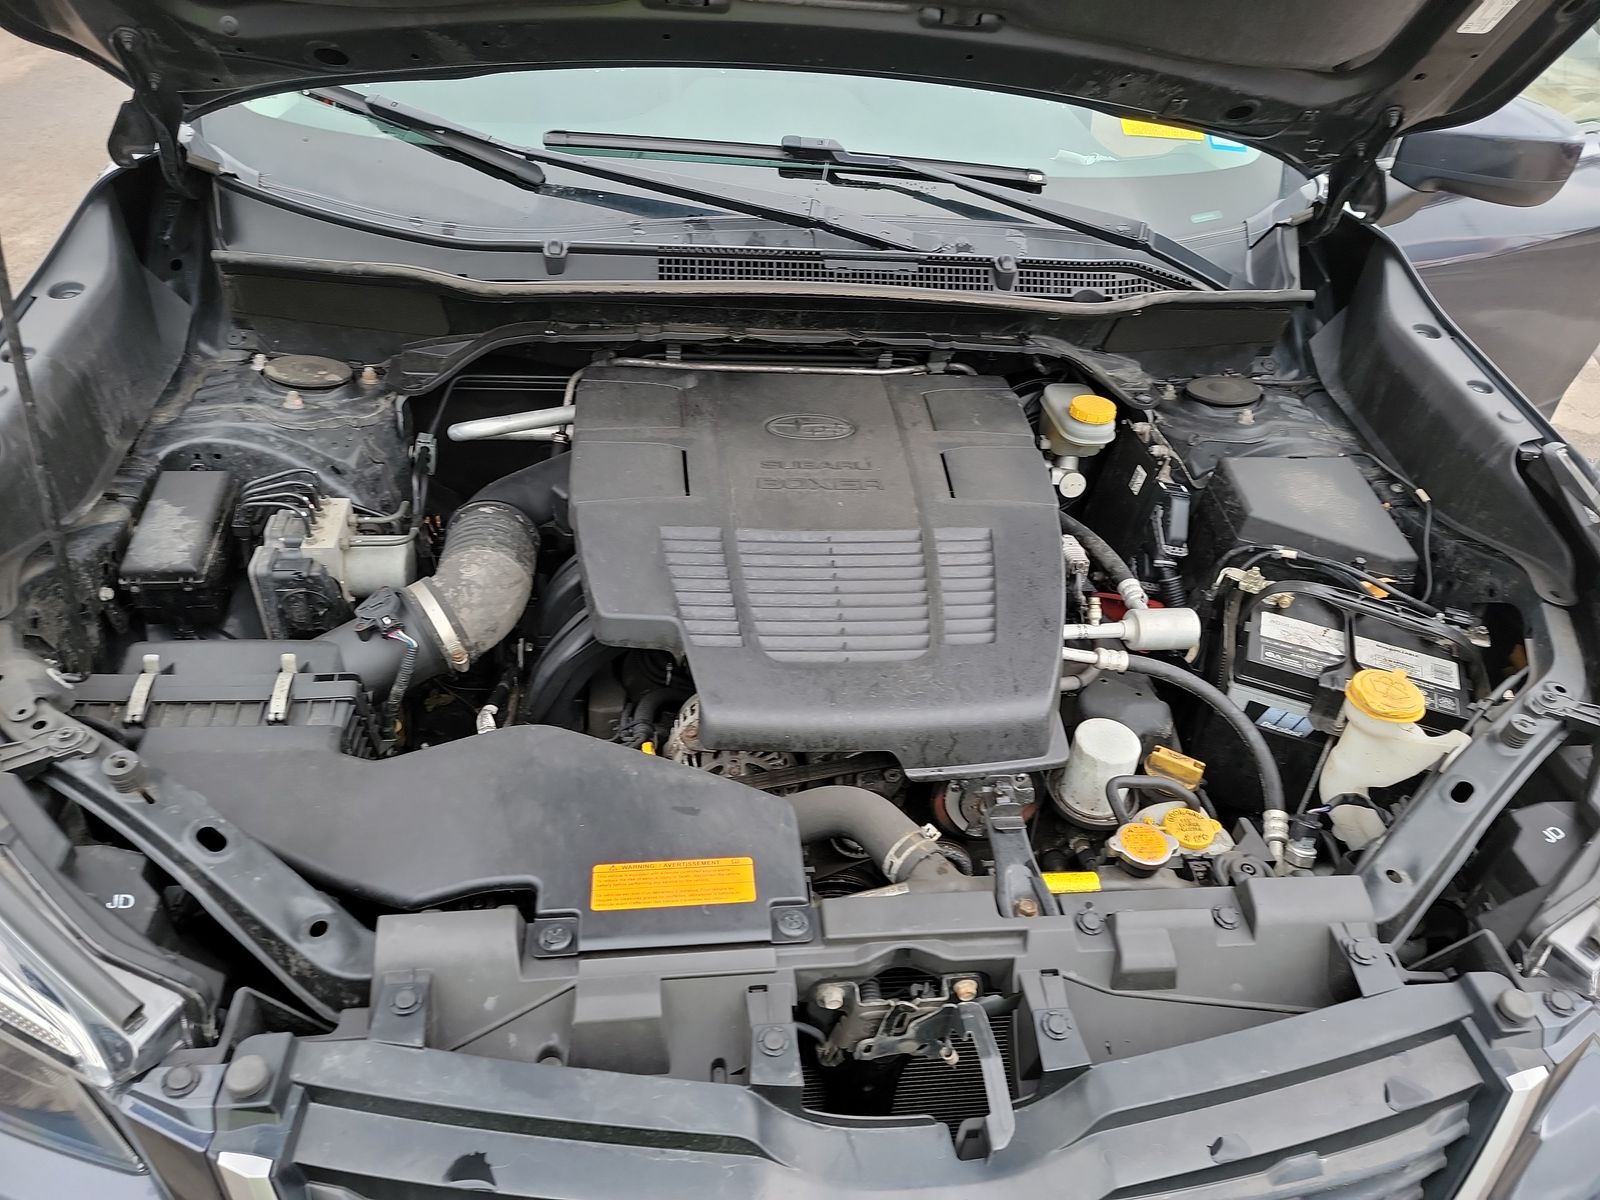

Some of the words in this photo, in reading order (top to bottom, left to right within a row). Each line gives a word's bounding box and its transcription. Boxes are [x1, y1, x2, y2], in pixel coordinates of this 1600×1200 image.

[760, 460, 872, 471] SUBARU
[756, 477, 885, 491] BOXER
[1542, 826, 1566, 843] JD
[664, 860, 720, 868] AVERTISSEMENT
[105, 894, 135, 908] JD
